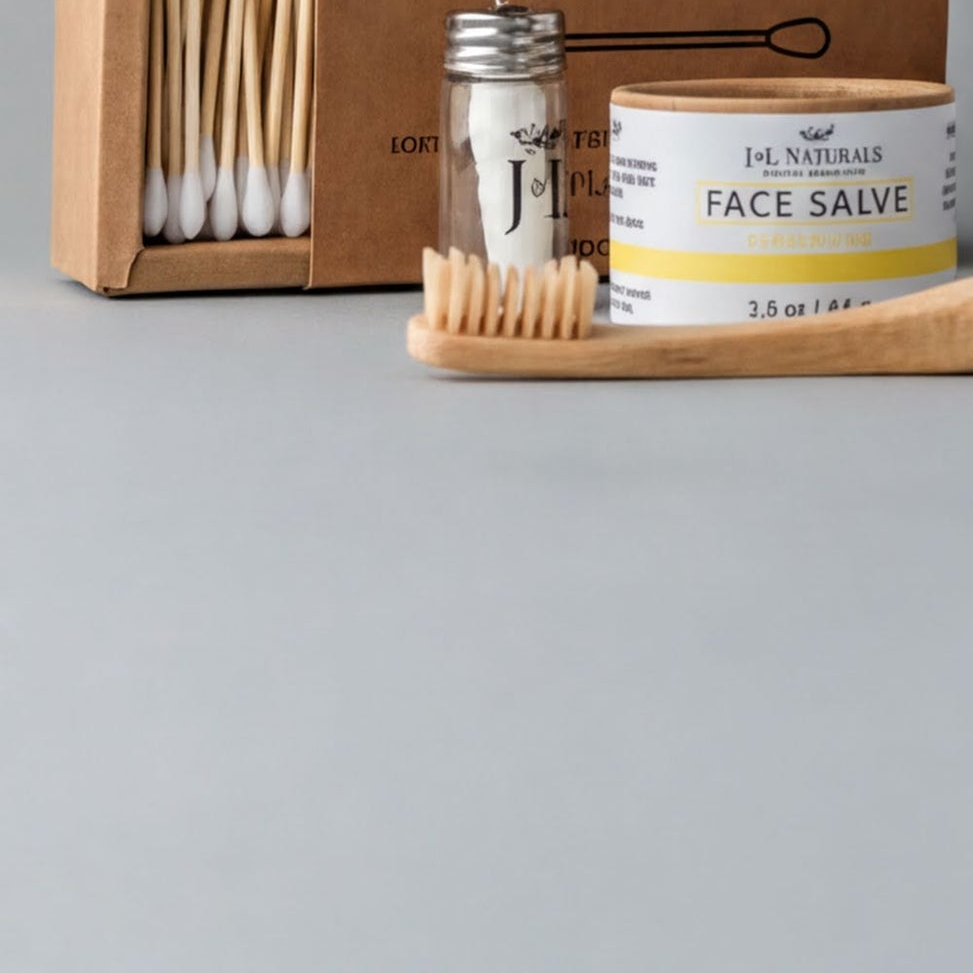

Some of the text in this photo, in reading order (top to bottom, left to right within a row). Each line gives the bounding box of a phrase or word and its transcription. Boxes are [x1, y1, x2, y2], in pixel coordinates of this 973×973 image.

[785, 145, 884, 166] NATURALS
[707, 184, 909, 218] FACE SALVE
